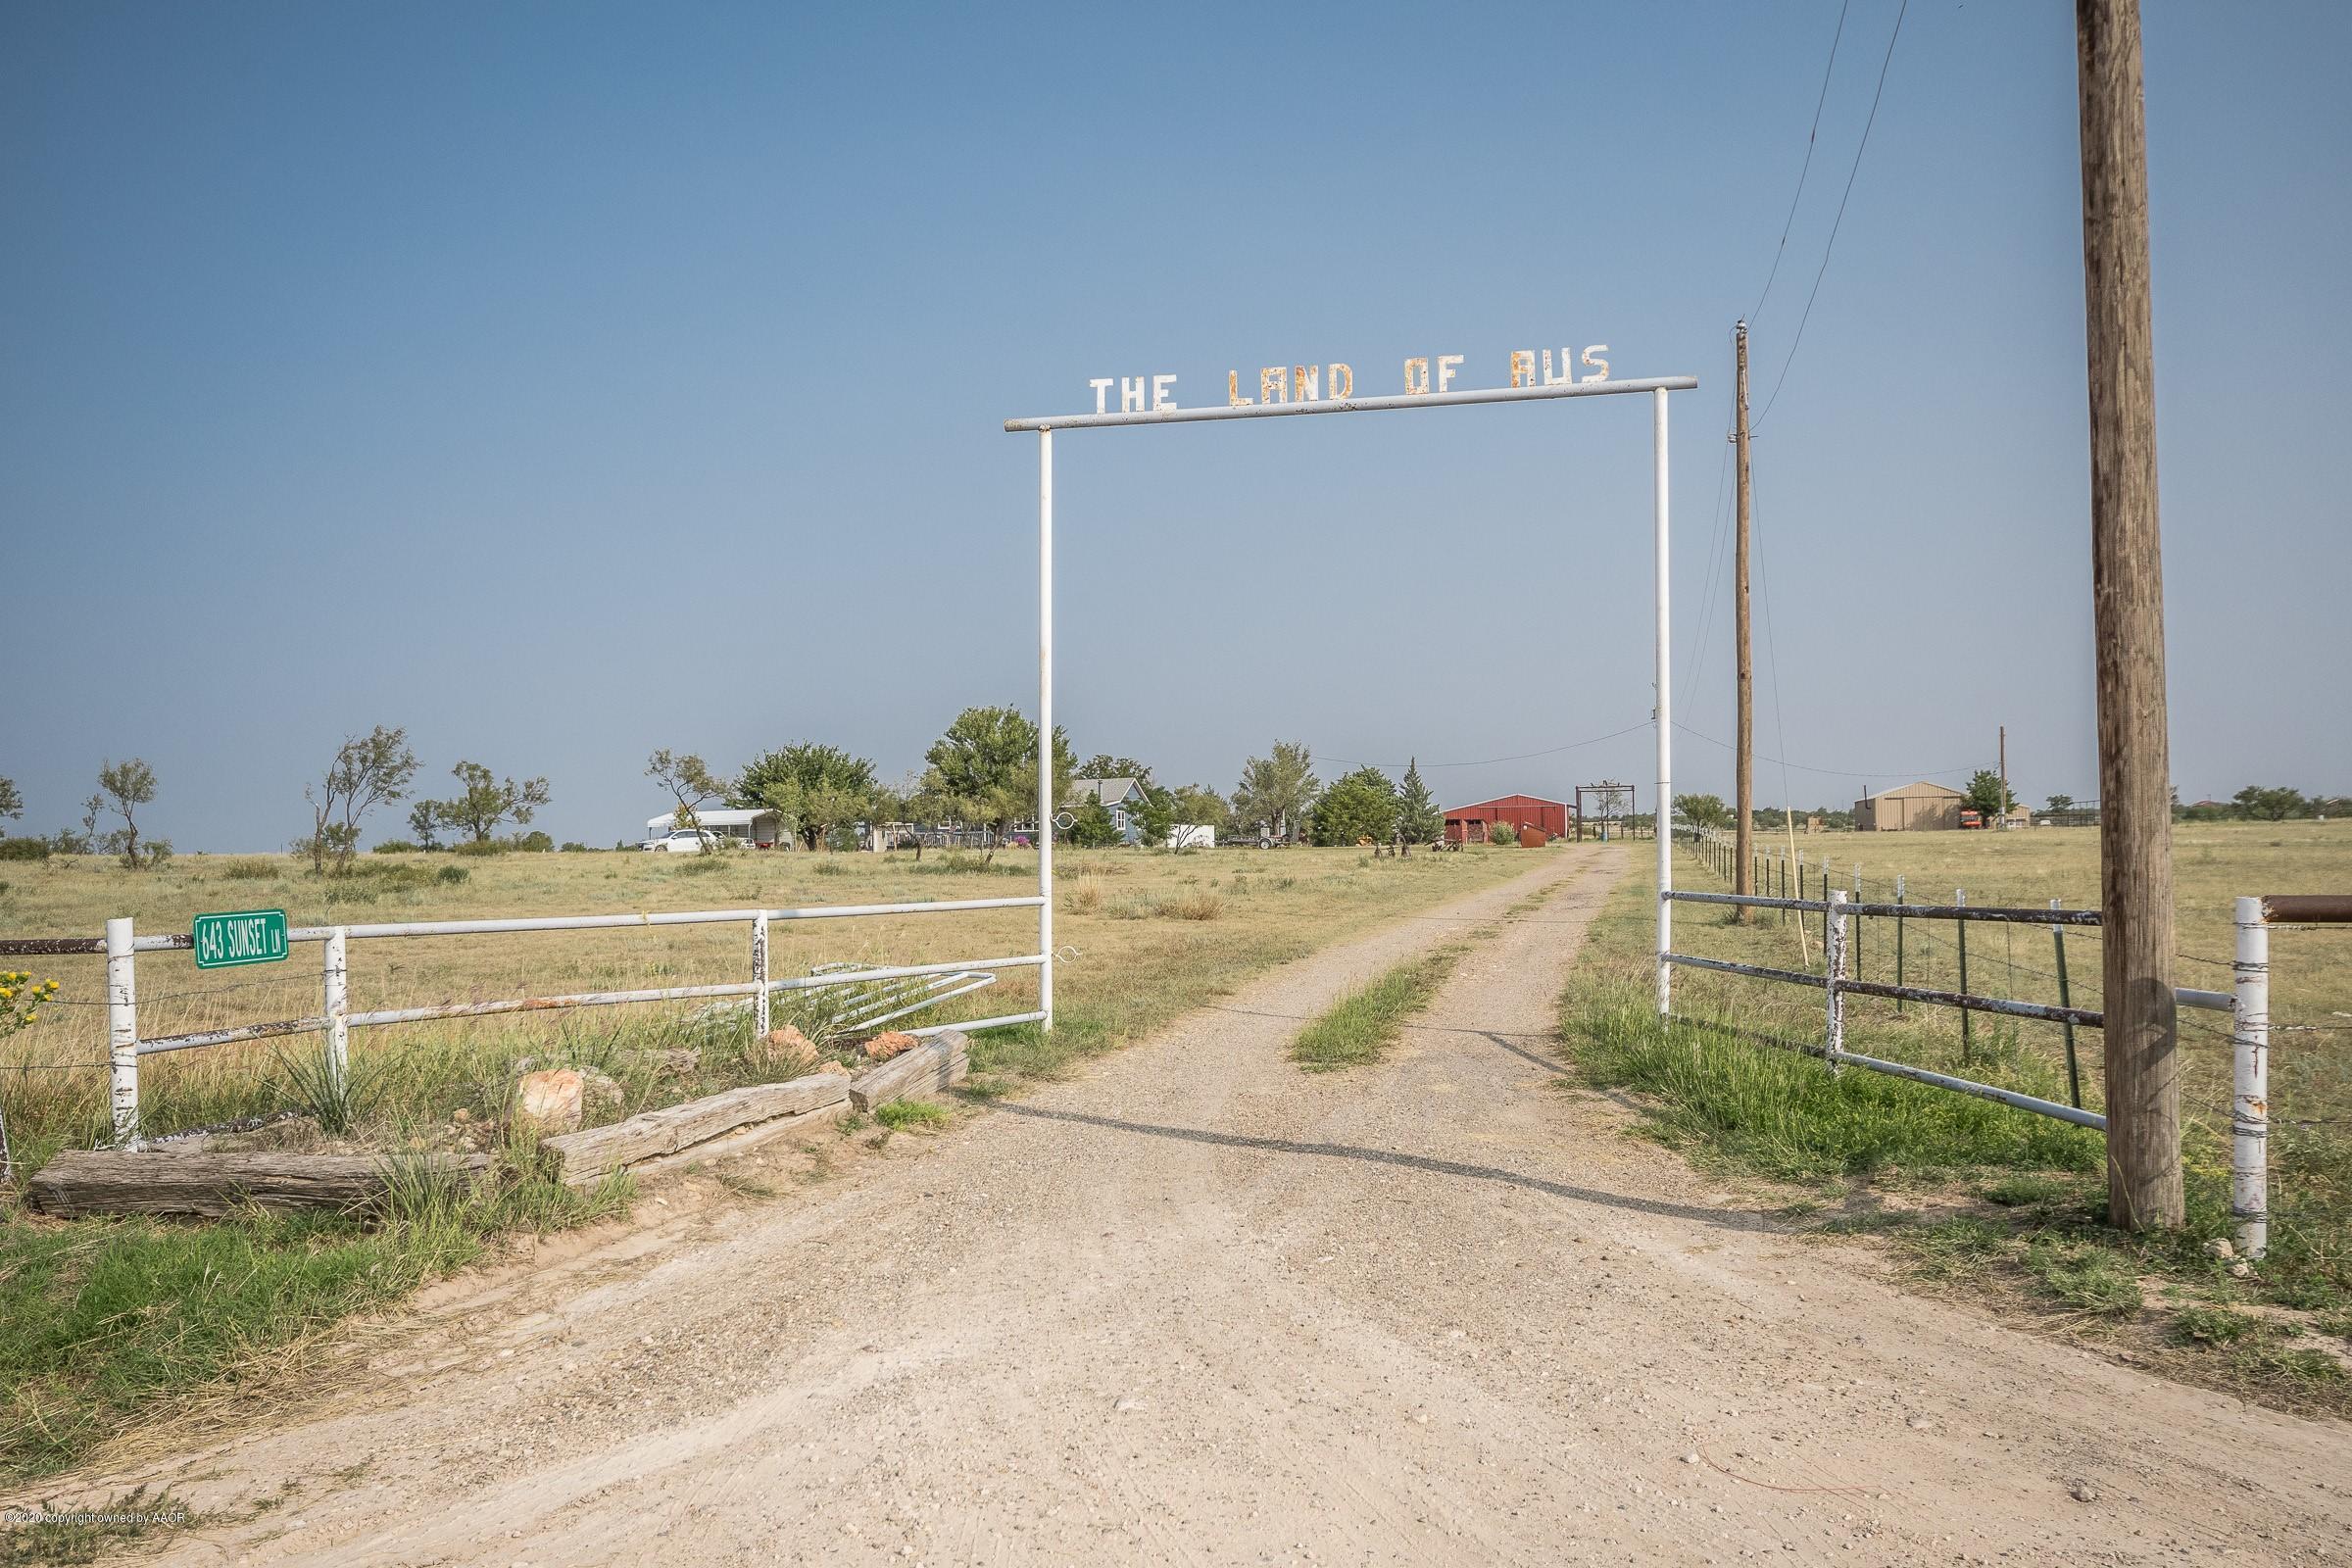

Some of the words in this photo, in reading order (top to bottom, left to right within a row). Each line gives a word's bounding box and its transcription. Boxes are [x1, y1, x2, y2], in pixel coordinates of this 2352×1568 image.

[1090, 374, 1177, 414] THE
[1229, 363, 1352, 407] LAND
[1403, 354, 1464, 395] OF
[202, 921, 223, 960] 643
[227, 918, 267, 957] SUNSET
[270, 929, 281, 953] LN
